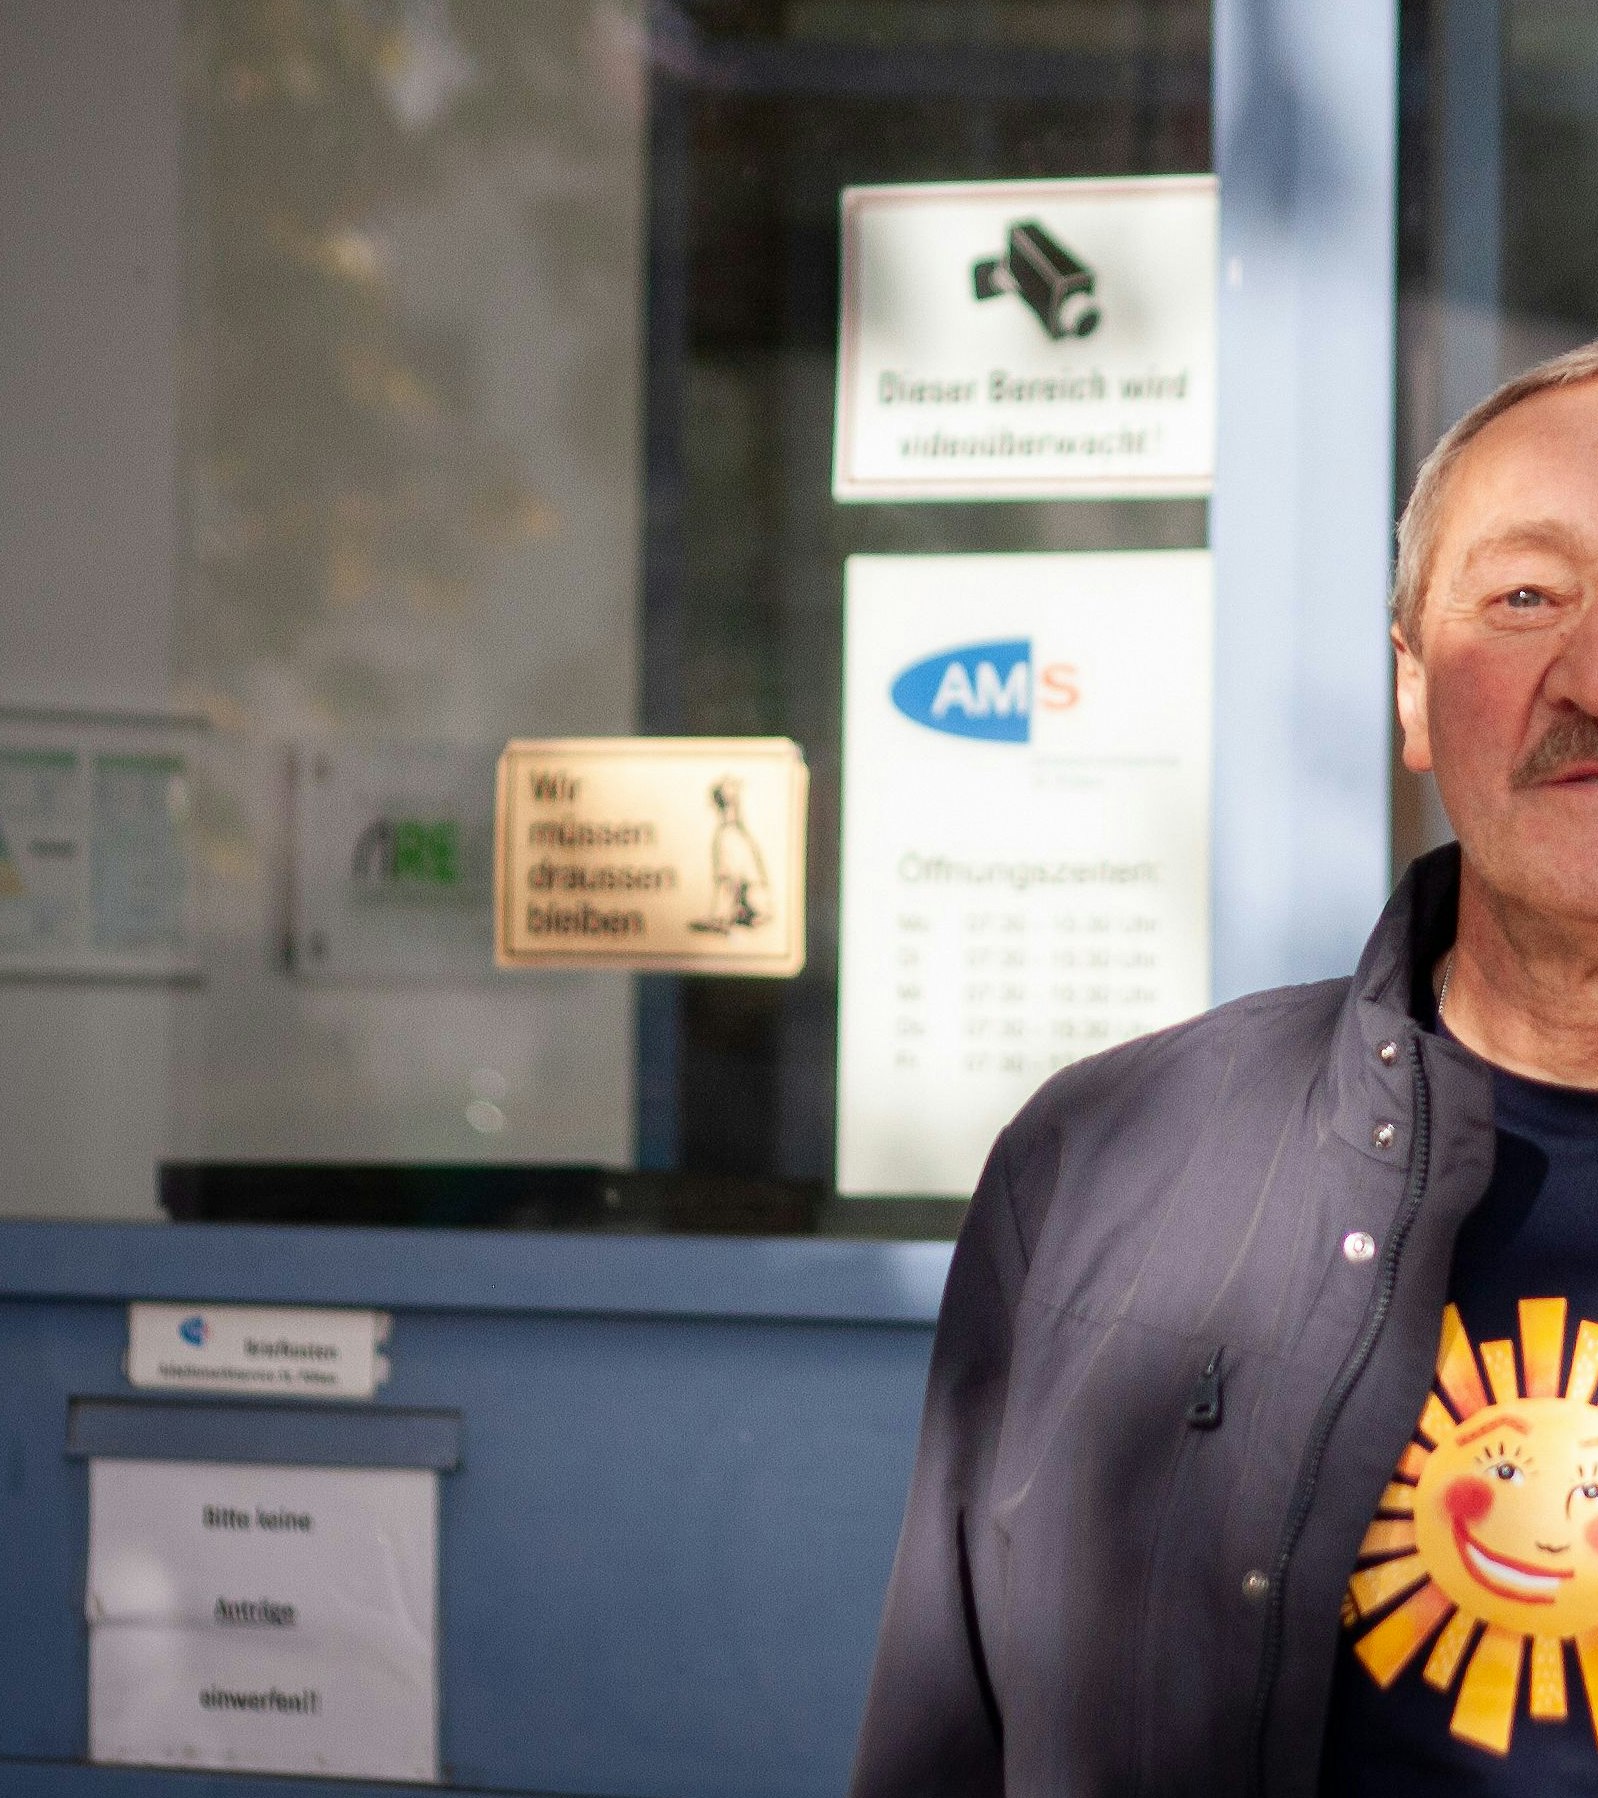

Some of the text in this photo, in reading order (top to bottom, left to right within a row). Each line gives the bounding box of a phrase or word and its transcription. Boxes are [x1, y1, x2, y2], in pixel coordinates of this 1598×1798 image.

[878, 367, 1188, 405] Dieser Bereich wird
[931, 660, 1081, 720] AMS
[530, 769, 580, 800] Wir
[529, 813, 655, 847] müssen
[528, 858, 678, 890] draussen
[527, 902, 645, 935] bleiben
[202, 1504, 312, 1533] Bitte keine
[214, 1597, 296, 1626] Anträge
